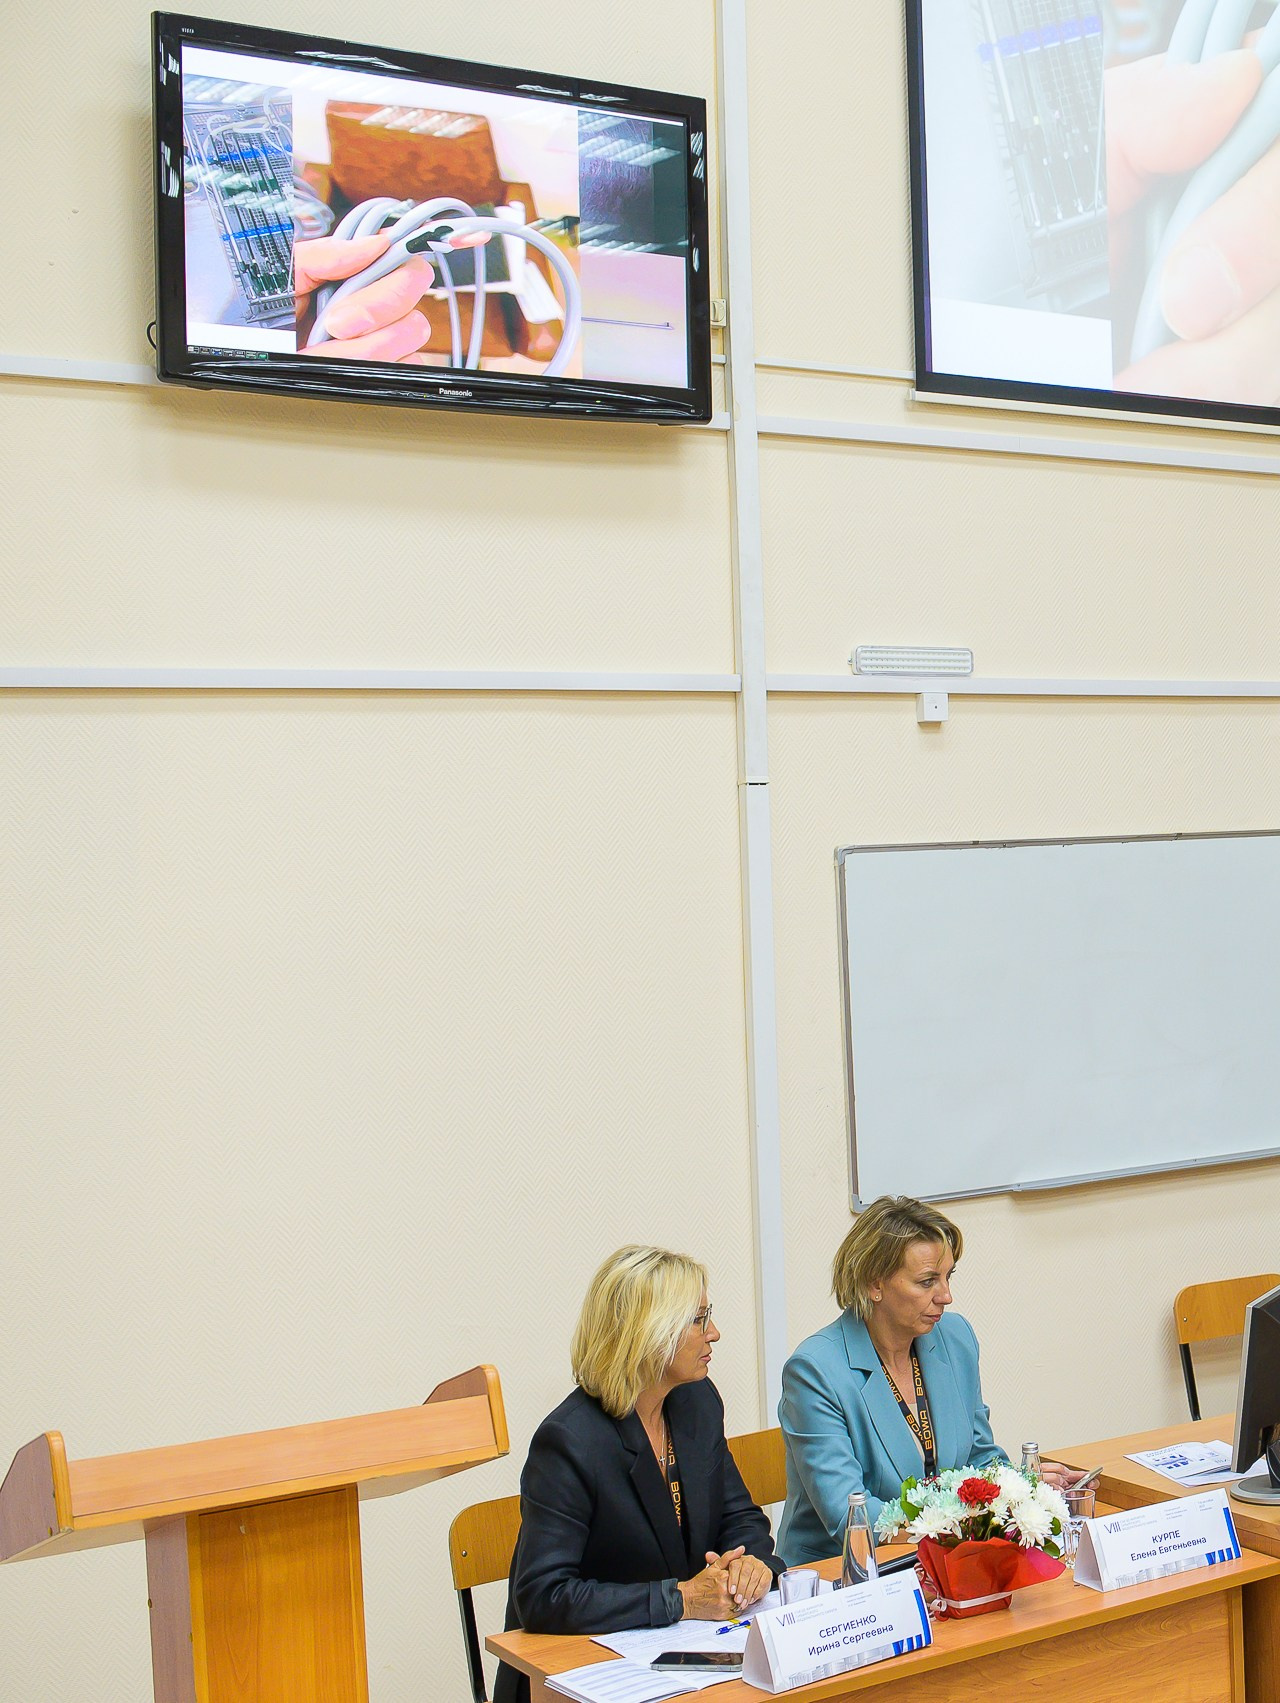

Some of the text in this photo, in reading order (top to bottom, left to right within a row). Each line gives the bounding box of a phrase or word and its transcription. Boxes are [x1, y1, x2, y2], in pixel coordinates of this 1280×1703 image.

[439, 387, 472, 397] Panasonic
[919, 1410, 933, 1450] BOWA
[670, 1481, 681, 1526] BOW
[1103, 1521, 1121, 1534] VIII
[1151, 1529, 1181, 1544] КУРПЕ
[1130, 1536, 1207, 1562] Елена Евгеньевна
[775, 1612, 796, 1627] VIII
[819, 1614, 877, 1639] СЕРГИЕНКО
[808, 1623, 894, 1656] Ирина Сергеевна
